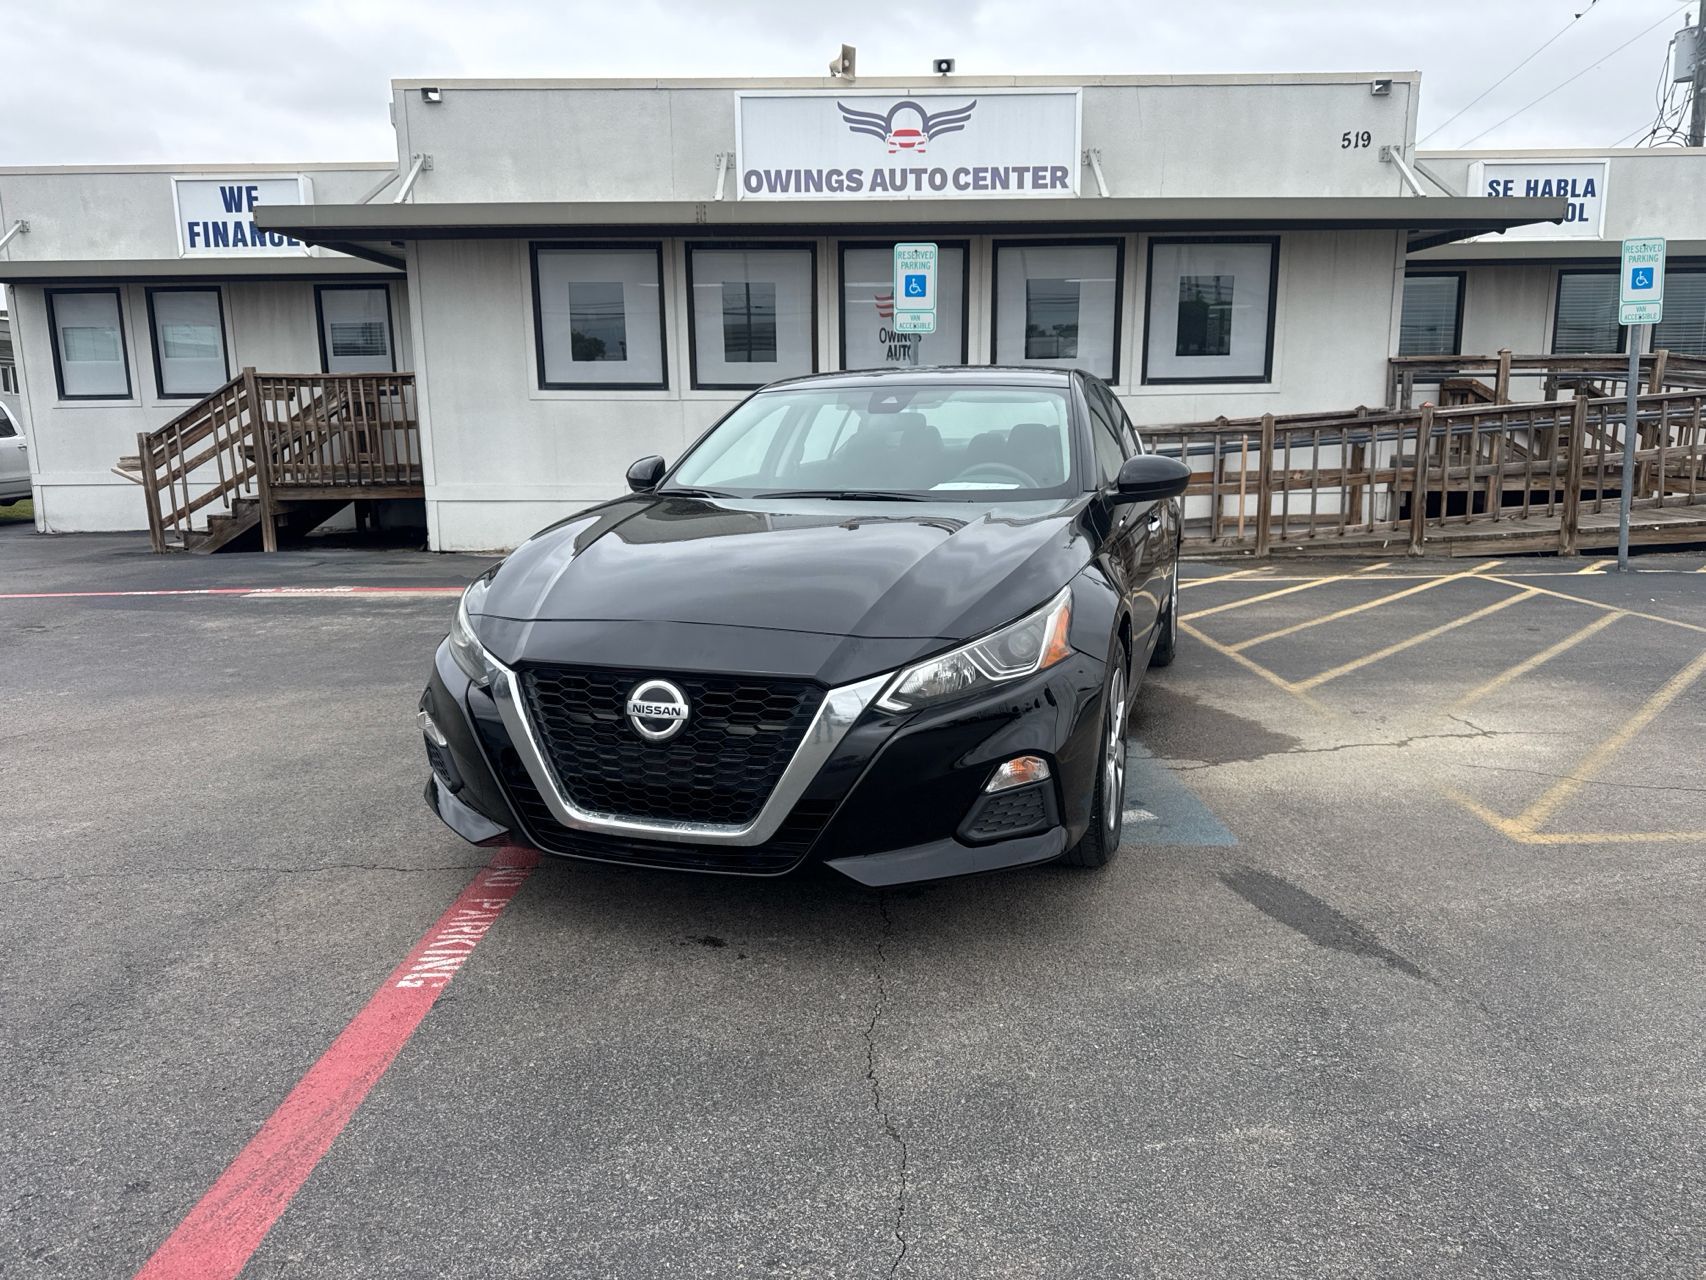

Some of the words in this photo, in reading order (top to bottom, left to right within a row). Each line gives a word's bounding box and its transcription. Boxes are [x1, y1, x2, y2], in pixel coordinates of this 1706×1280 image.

[1341, 131, 1372, 149] 519
[744, 168, 864, 193] OWINGS
[869, 167, 948, 192] AUTO
[952, 165, 1069, 191] CENTER
[1487, 180, 1515, 197] SE
[1525, 178, 1597, 198] HABLA
[219, 185, 260, 213] WE
[1625, 243, 1663, 254] RESERVED
[897, 250, 935, 260] RESERVED
[1628, 254, 1660, 264] PARKING
[900, 261, 932, 271] PARKING
[1635, 305, 1647, 313] VAN
[910, 314, 921, 322] VAN
[632, 704, 681, 716] NISSAN
[396, 898, 513, 988] PARKING
